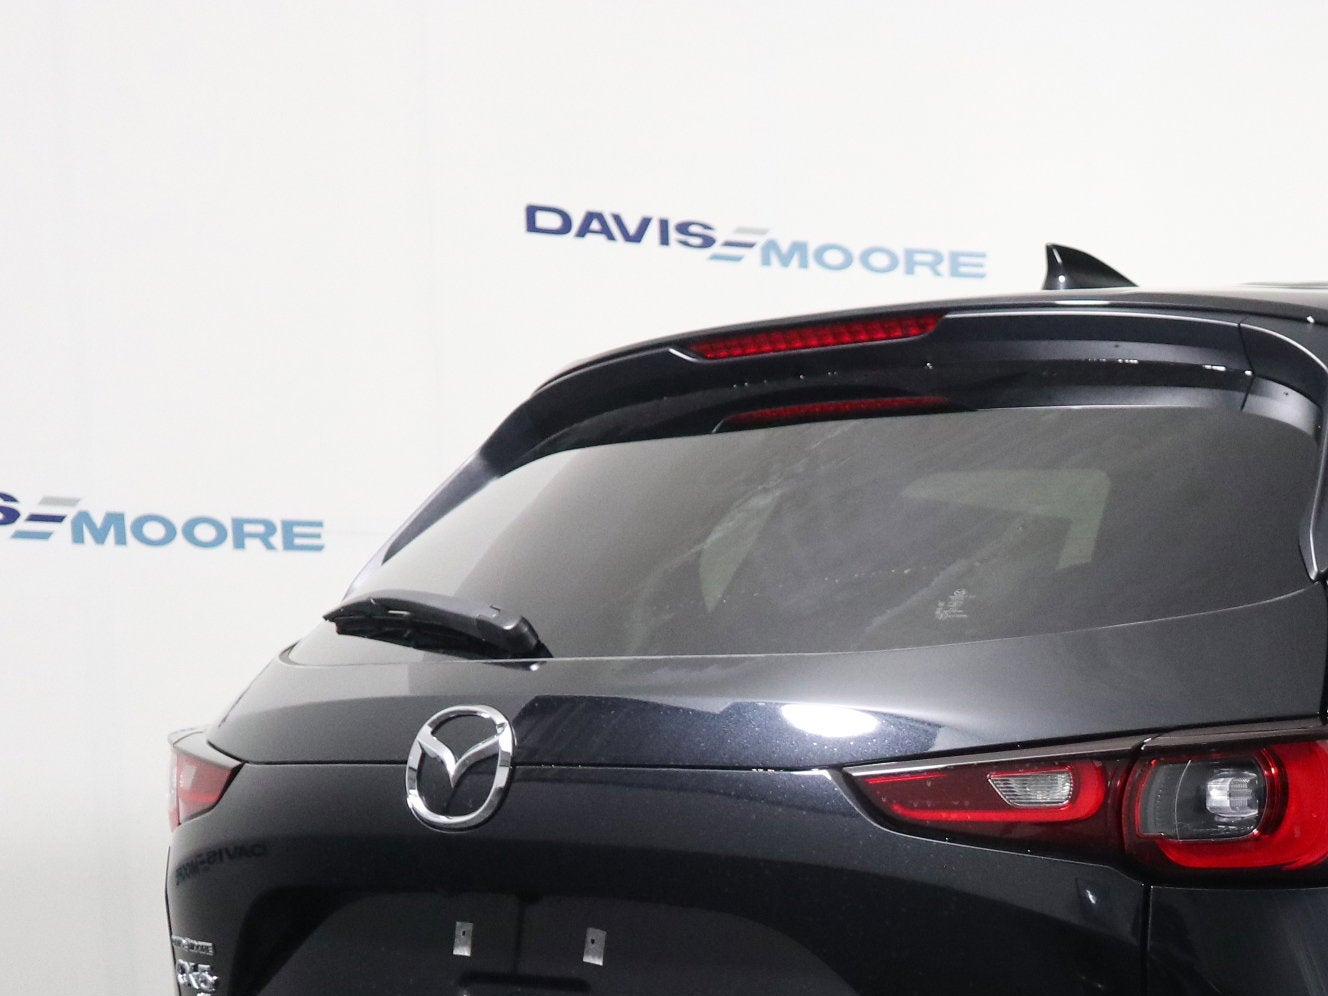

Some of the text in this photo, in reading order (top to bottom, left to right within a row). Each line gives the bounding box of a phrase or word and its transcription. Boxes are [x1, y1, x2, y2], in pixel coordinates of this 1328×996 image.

[525, 203, 988, 279] DAVIS MOORE
[70, 509, 325, 553] MOORE
